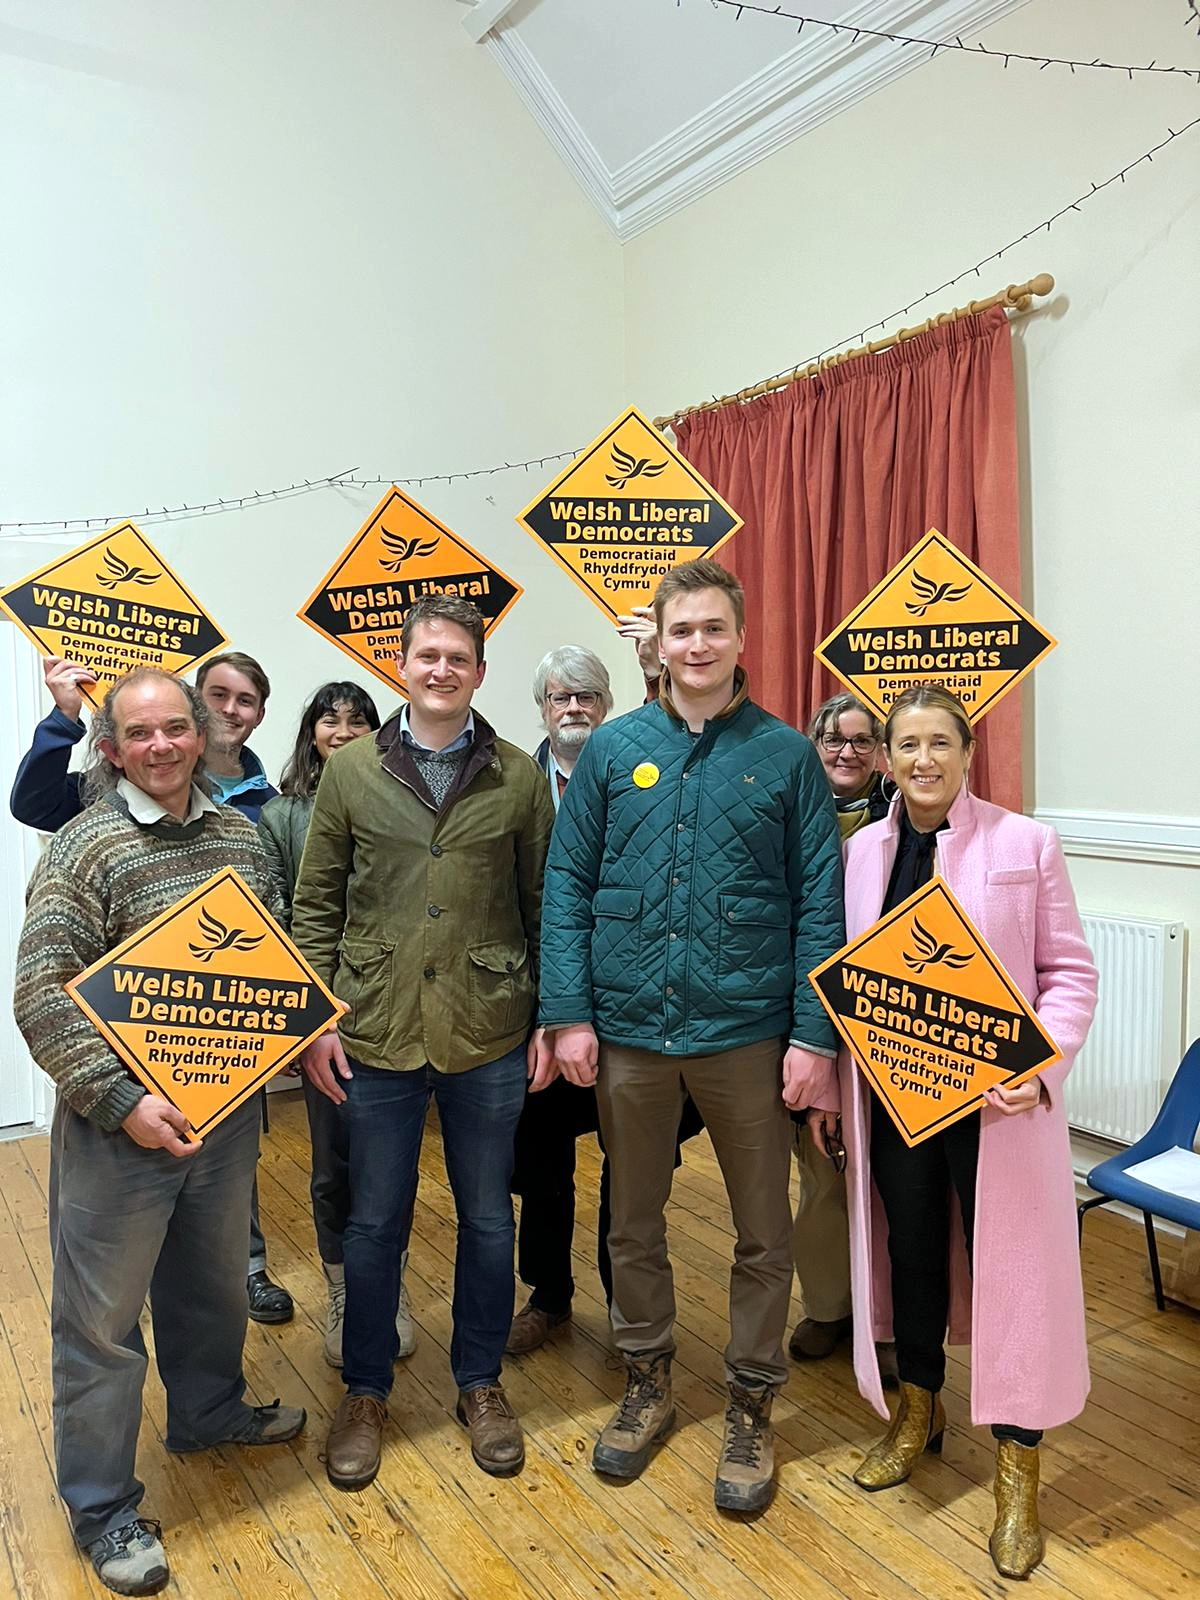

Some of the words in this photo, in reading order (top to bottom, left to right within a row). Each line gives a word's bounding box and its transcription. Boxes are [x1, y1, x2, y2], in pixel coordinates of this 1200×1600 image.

[550, 501, 621, 521] Welsh
[629, 502, 710, 523] Liberal
[566, 522, 693, 543] Democrats
[579, 548, 676, 561] Democratiaid
[584, 562, 671, 578] Rhyddfrydol
[603, 577, 650, 592] Cymru
[32, 587, 110, 618] Welsh
[117, 603, 200, 635] Liberal
[328, 586, 402, 612] Welsh
[47, 609, 182, 650] Democrats
[847, 629, 922, 652] Welsh
[930, 624, 1019, 649] Liberal
[61, 635, 163, 664] Democratiaid
[863, 649, 1000, 671] Democrats
[113, 969, 204, 1000] Welsh
[212, 978, 308, 1009] Liberal
[129, 996, 287, 1031] Democrats
[841, 967, 916, 1010] Welsh
[924, 993, 1020, 1043] Liberal
[145, 1030, 265, 1051] Democratiaid
[854, 995, 998, 1060] Democrats
[148, 1049, 257, 1070] Rhyddfrydol
[867, 1029, 975, 1077] Democratiaid
[172, 1068, 230, 1087] Cymru
[870, 1047, 968, 1092] Rhyddfrydol
[890, 1072, 942, 1101] Cymru
